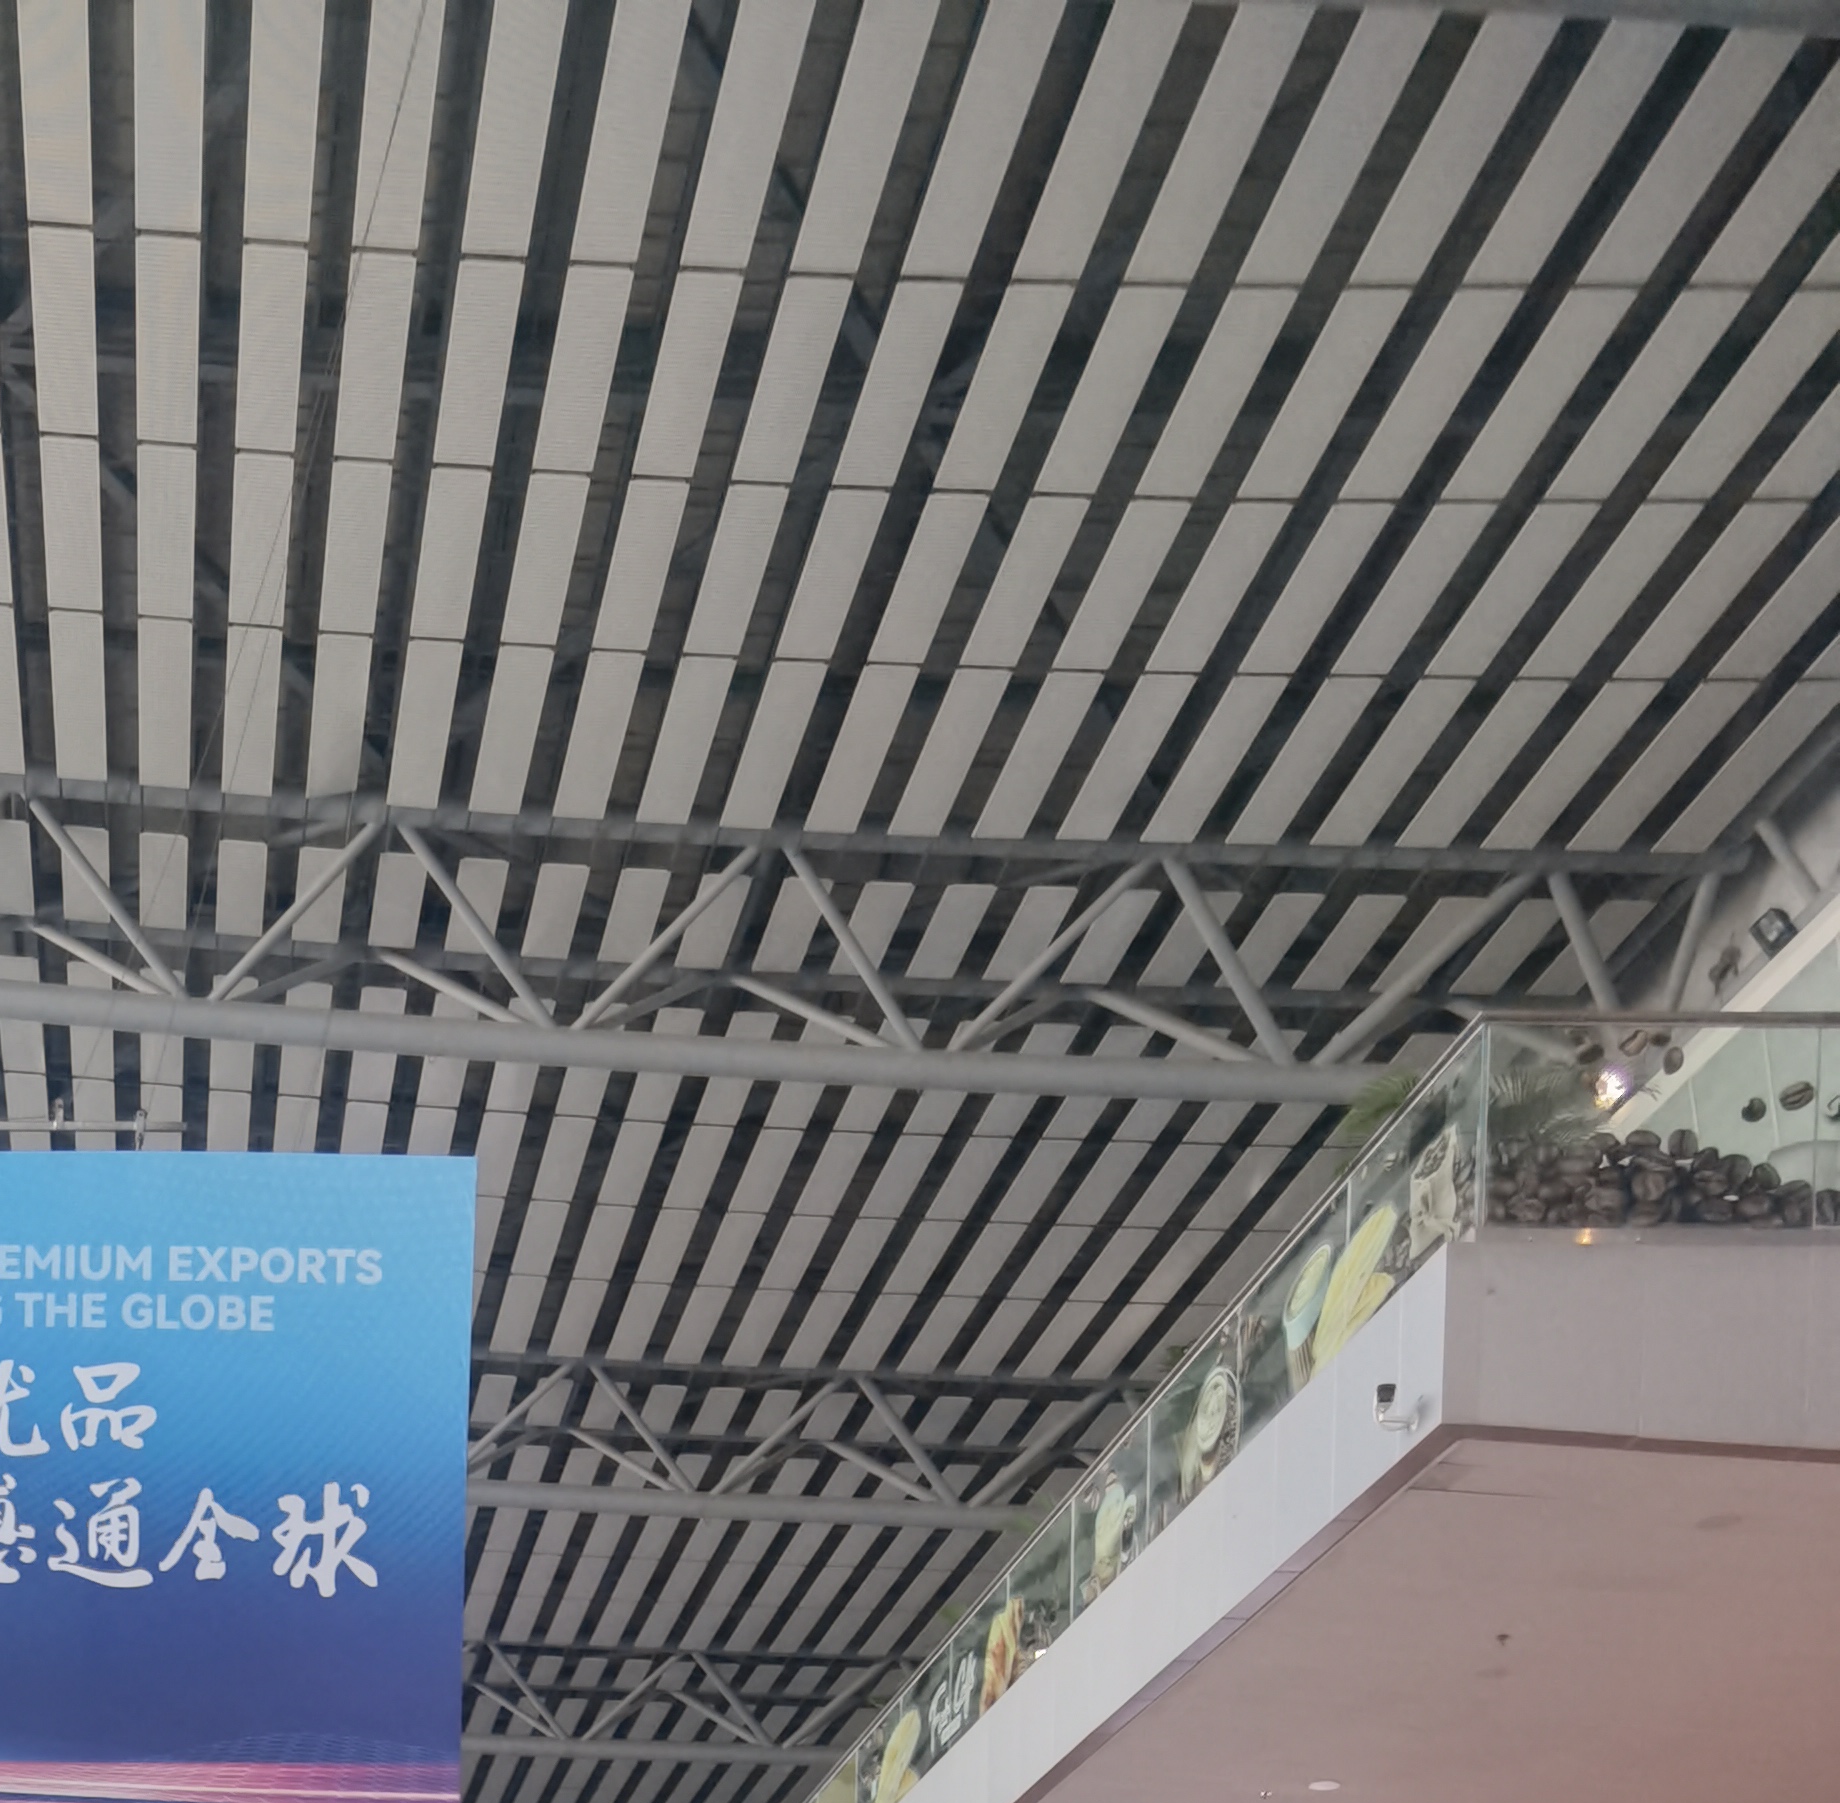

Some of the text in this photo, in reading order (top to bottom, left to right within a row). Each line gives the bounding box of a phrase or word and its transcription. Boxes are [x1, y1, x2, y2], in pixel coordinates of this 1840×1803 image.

[166, 1246, 384, 1288] EXPORTS
[13, 1293, 109, 1331] THE
[119, 1294, 277, 1334] GLOBE
